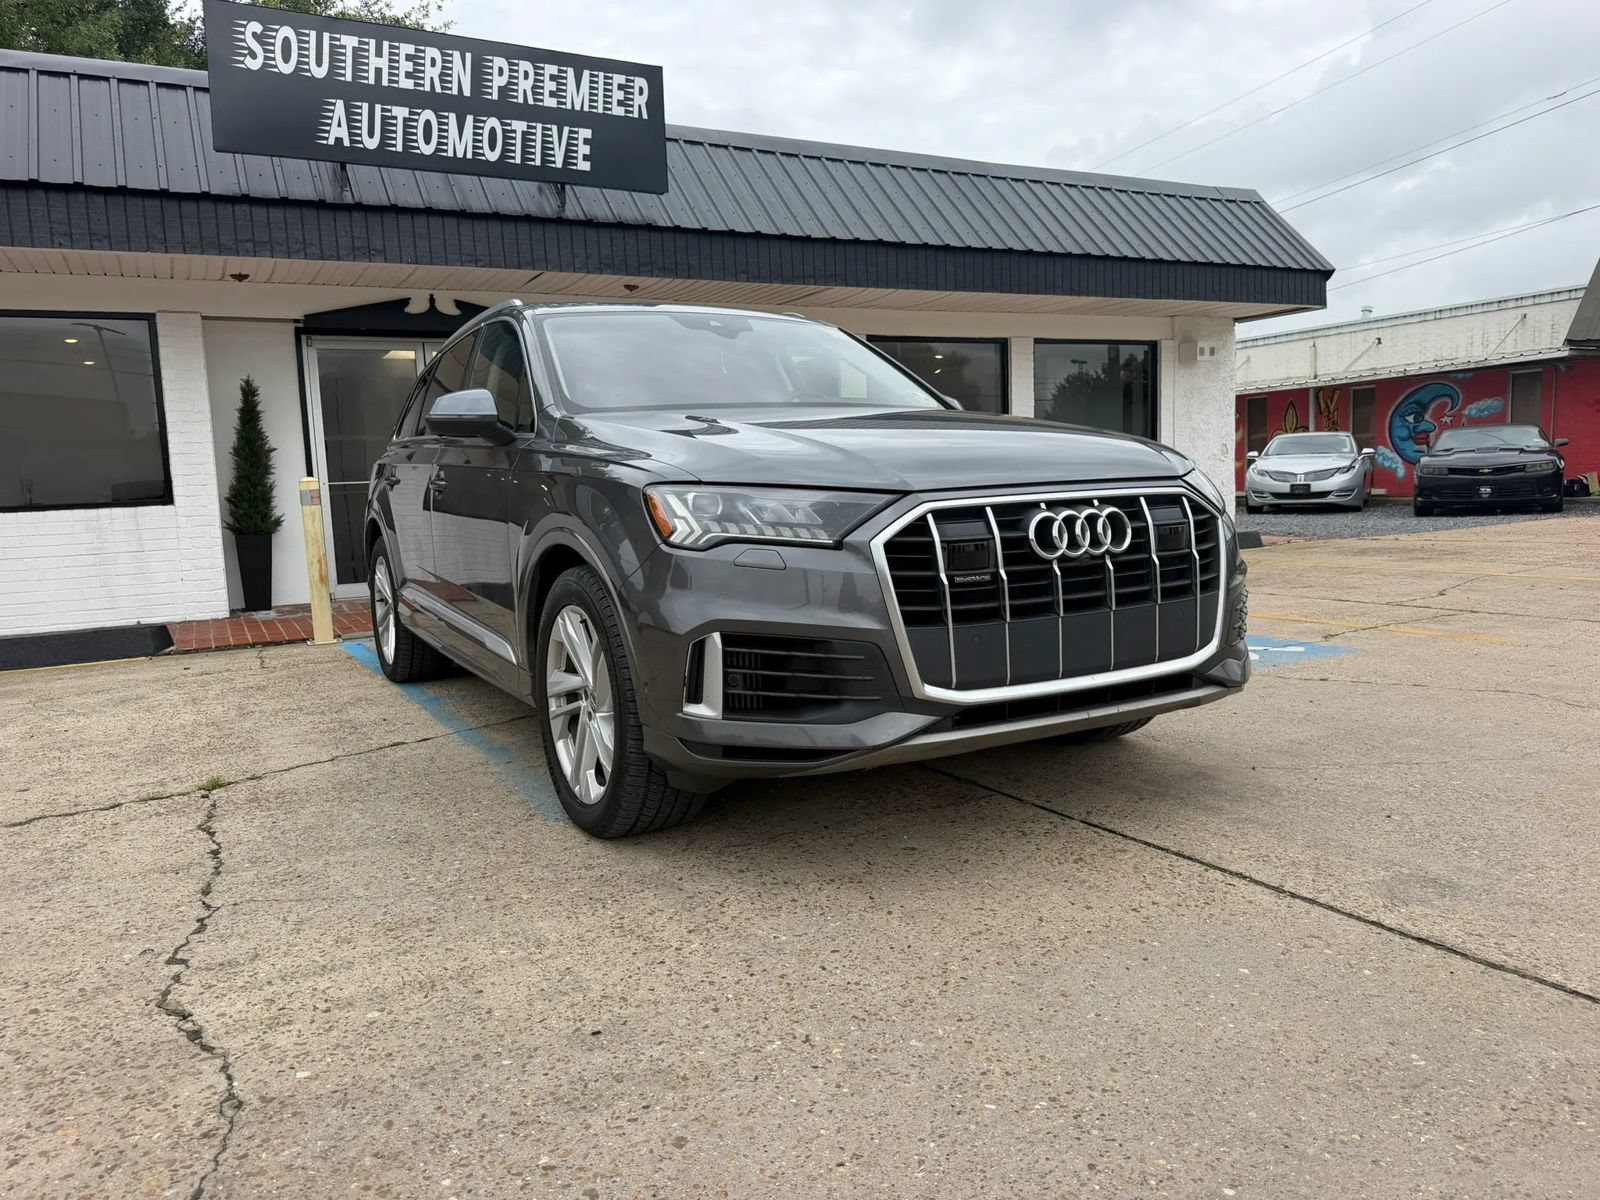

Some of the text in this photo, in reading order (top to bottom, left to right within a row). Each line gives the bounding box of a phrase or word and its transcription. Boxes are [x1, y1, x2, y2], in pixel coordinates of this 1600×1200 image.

[232, 20, 649, 119] SOUTHERN PREMIER
[316, 99, 592, 171] AUTOMOTIVE
